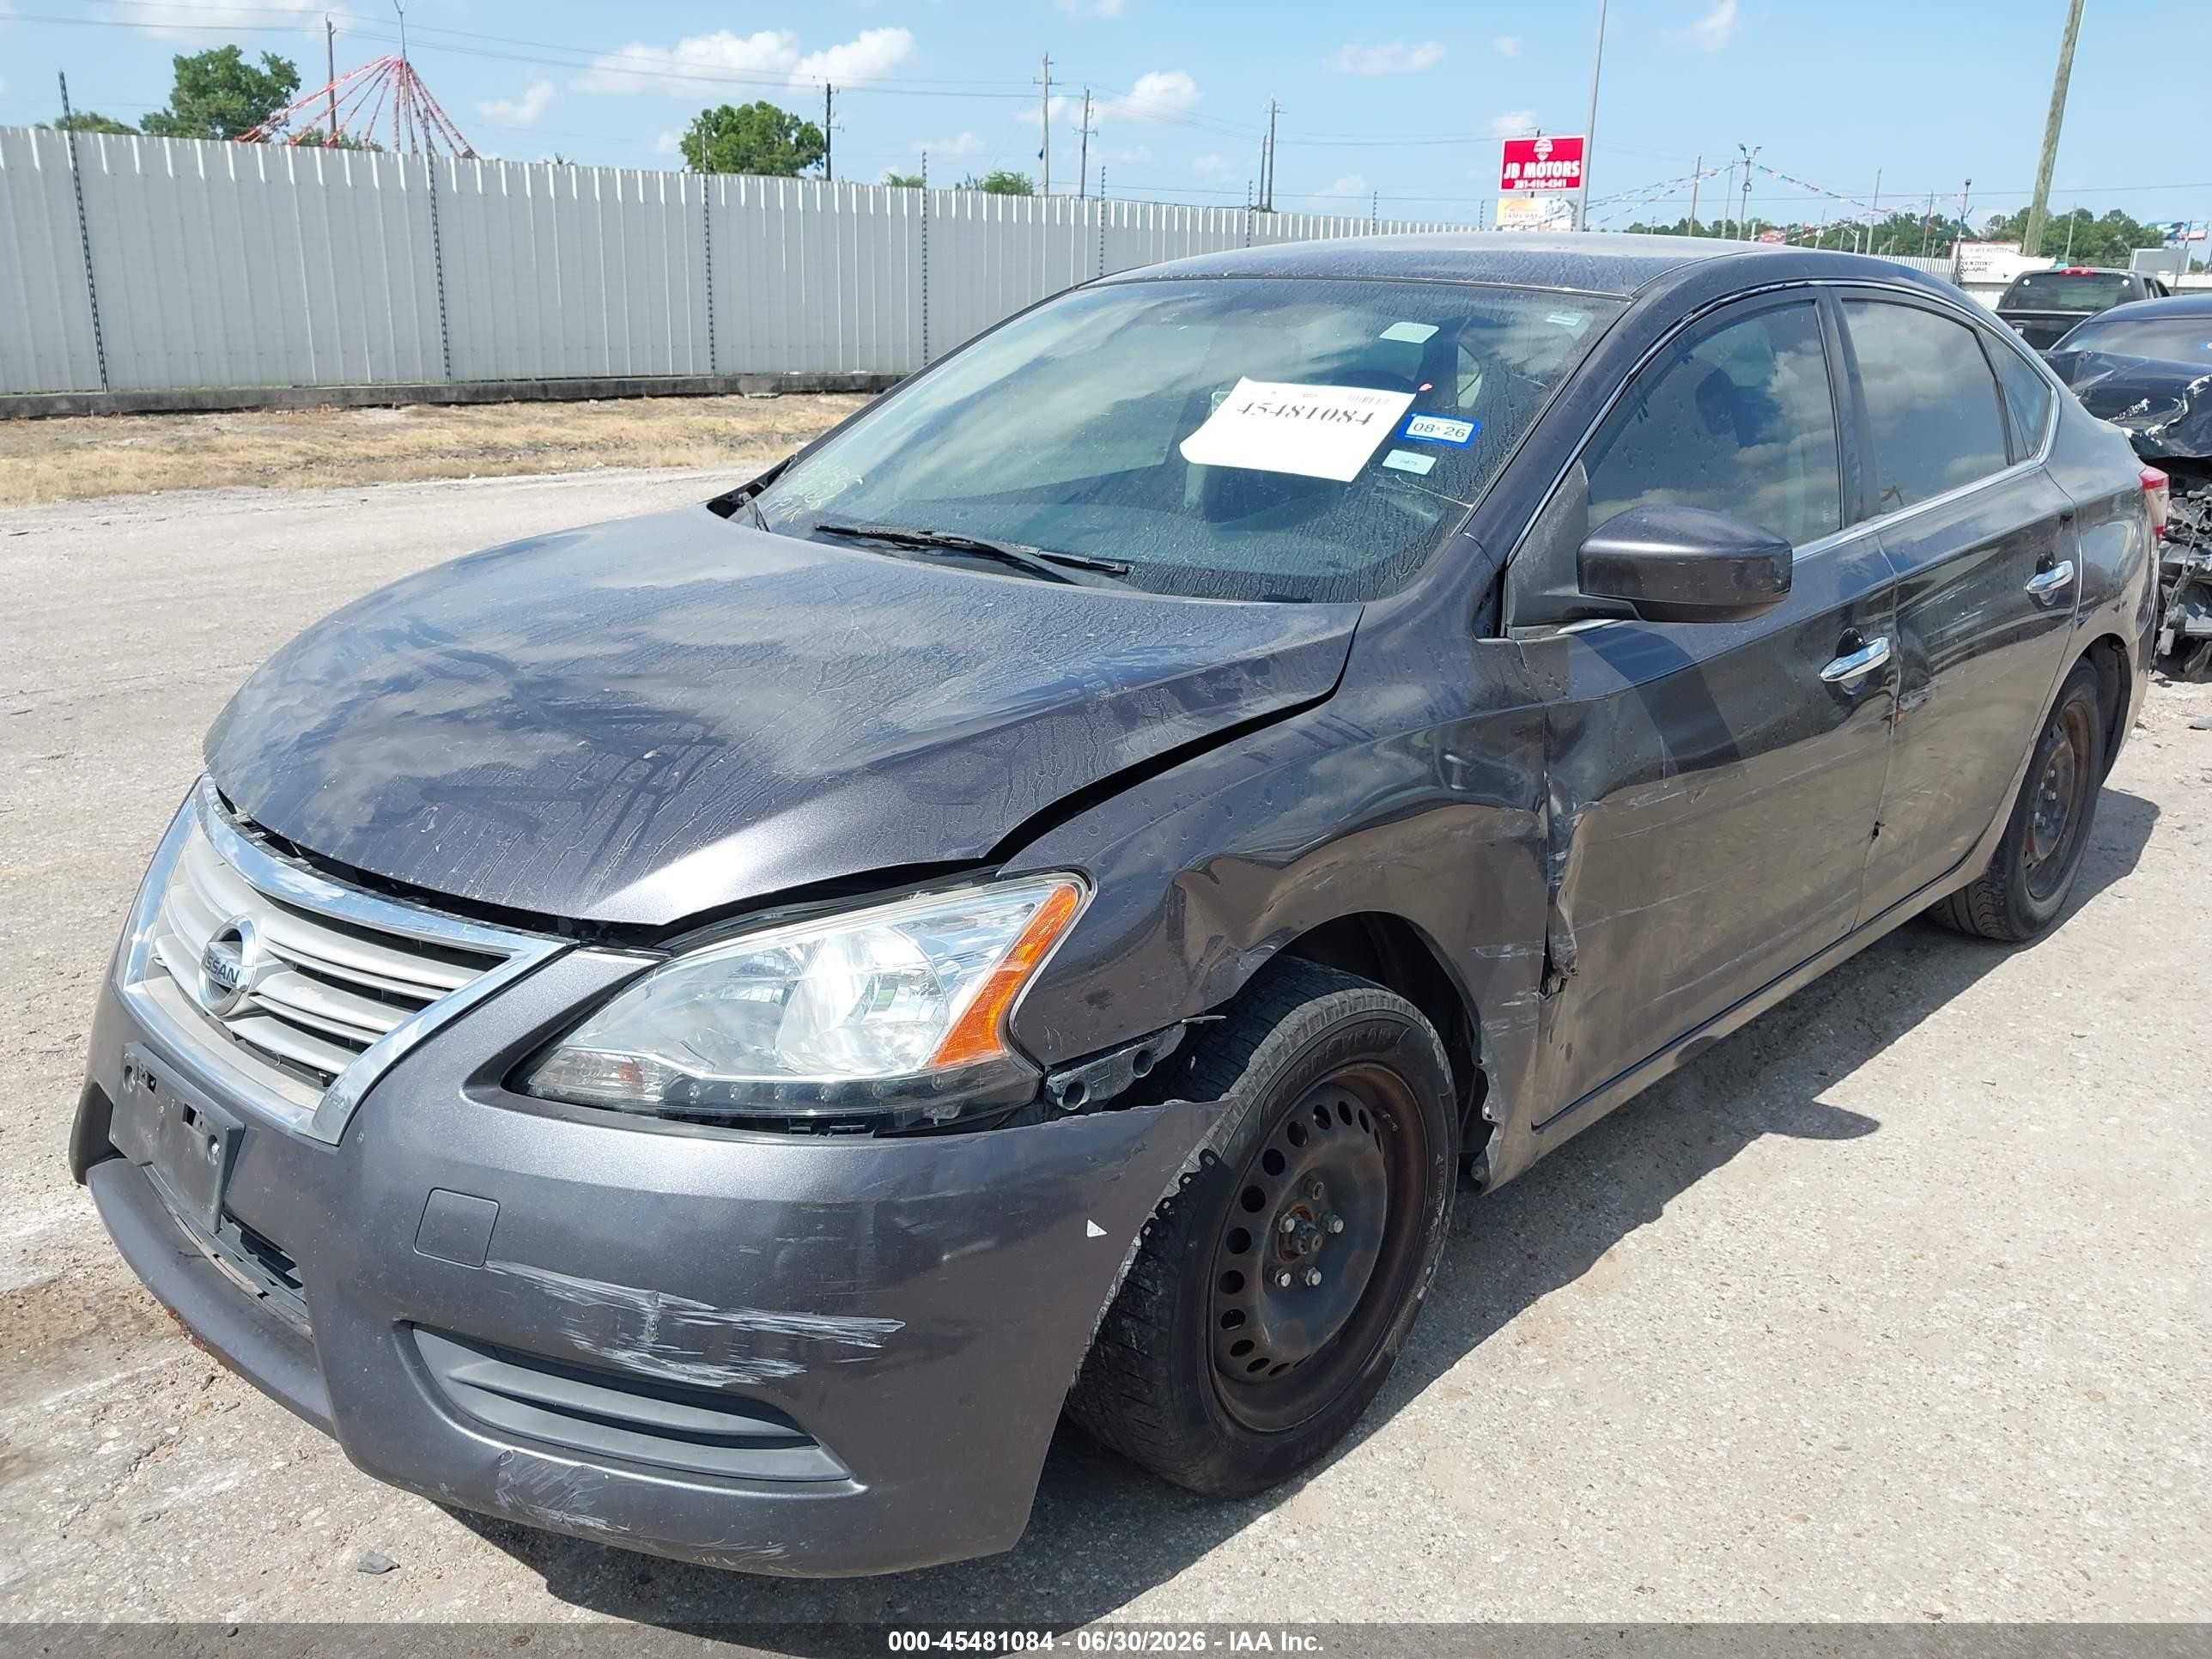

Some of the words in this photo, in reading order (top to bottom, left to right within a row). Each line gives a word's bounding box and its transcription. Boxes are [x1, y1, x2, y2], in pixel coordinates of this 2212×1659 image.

[1504, 162, 1521, 179] JB
[1523, 160, 1580, 179] MOTORS
[1237, 402, 1375, 425] 45481084
[1413, 422, 1436, 434] 08
[1443, 426, 1467, 438] 26
